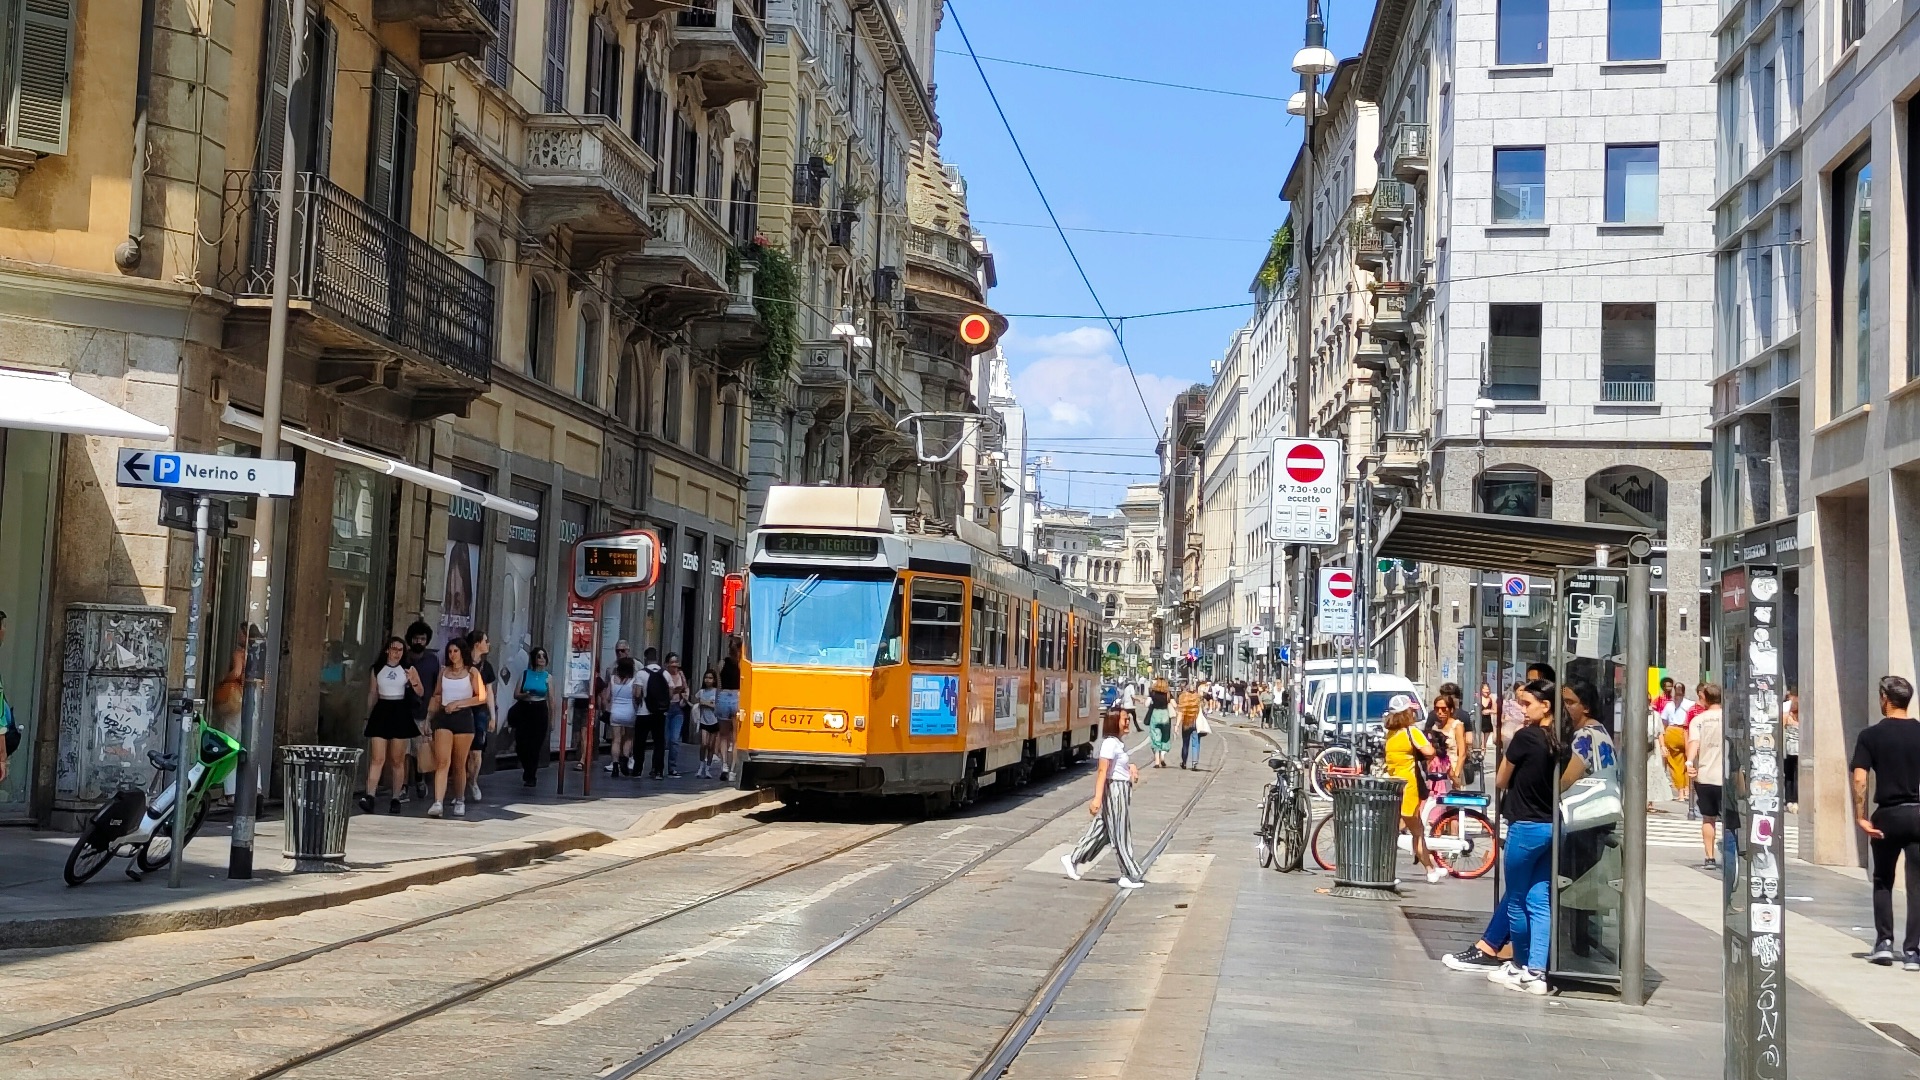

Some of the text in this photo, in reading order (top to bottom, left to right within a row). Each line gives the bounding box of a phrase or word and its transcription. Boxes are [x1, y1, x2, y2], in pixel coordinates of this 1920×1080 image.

[159, 458, 256, 481] P Nerino 6
[1287, 495, 1321, 503] eccetto
[509, 524, 536, 542] SETTEMBRE
[779, 537, 788, 549] 2
[819, 539, 871, 552] NEGRELLI
[1577, 599, 1606, 611] 2 3
[780, 714, 814, 725] 4977
